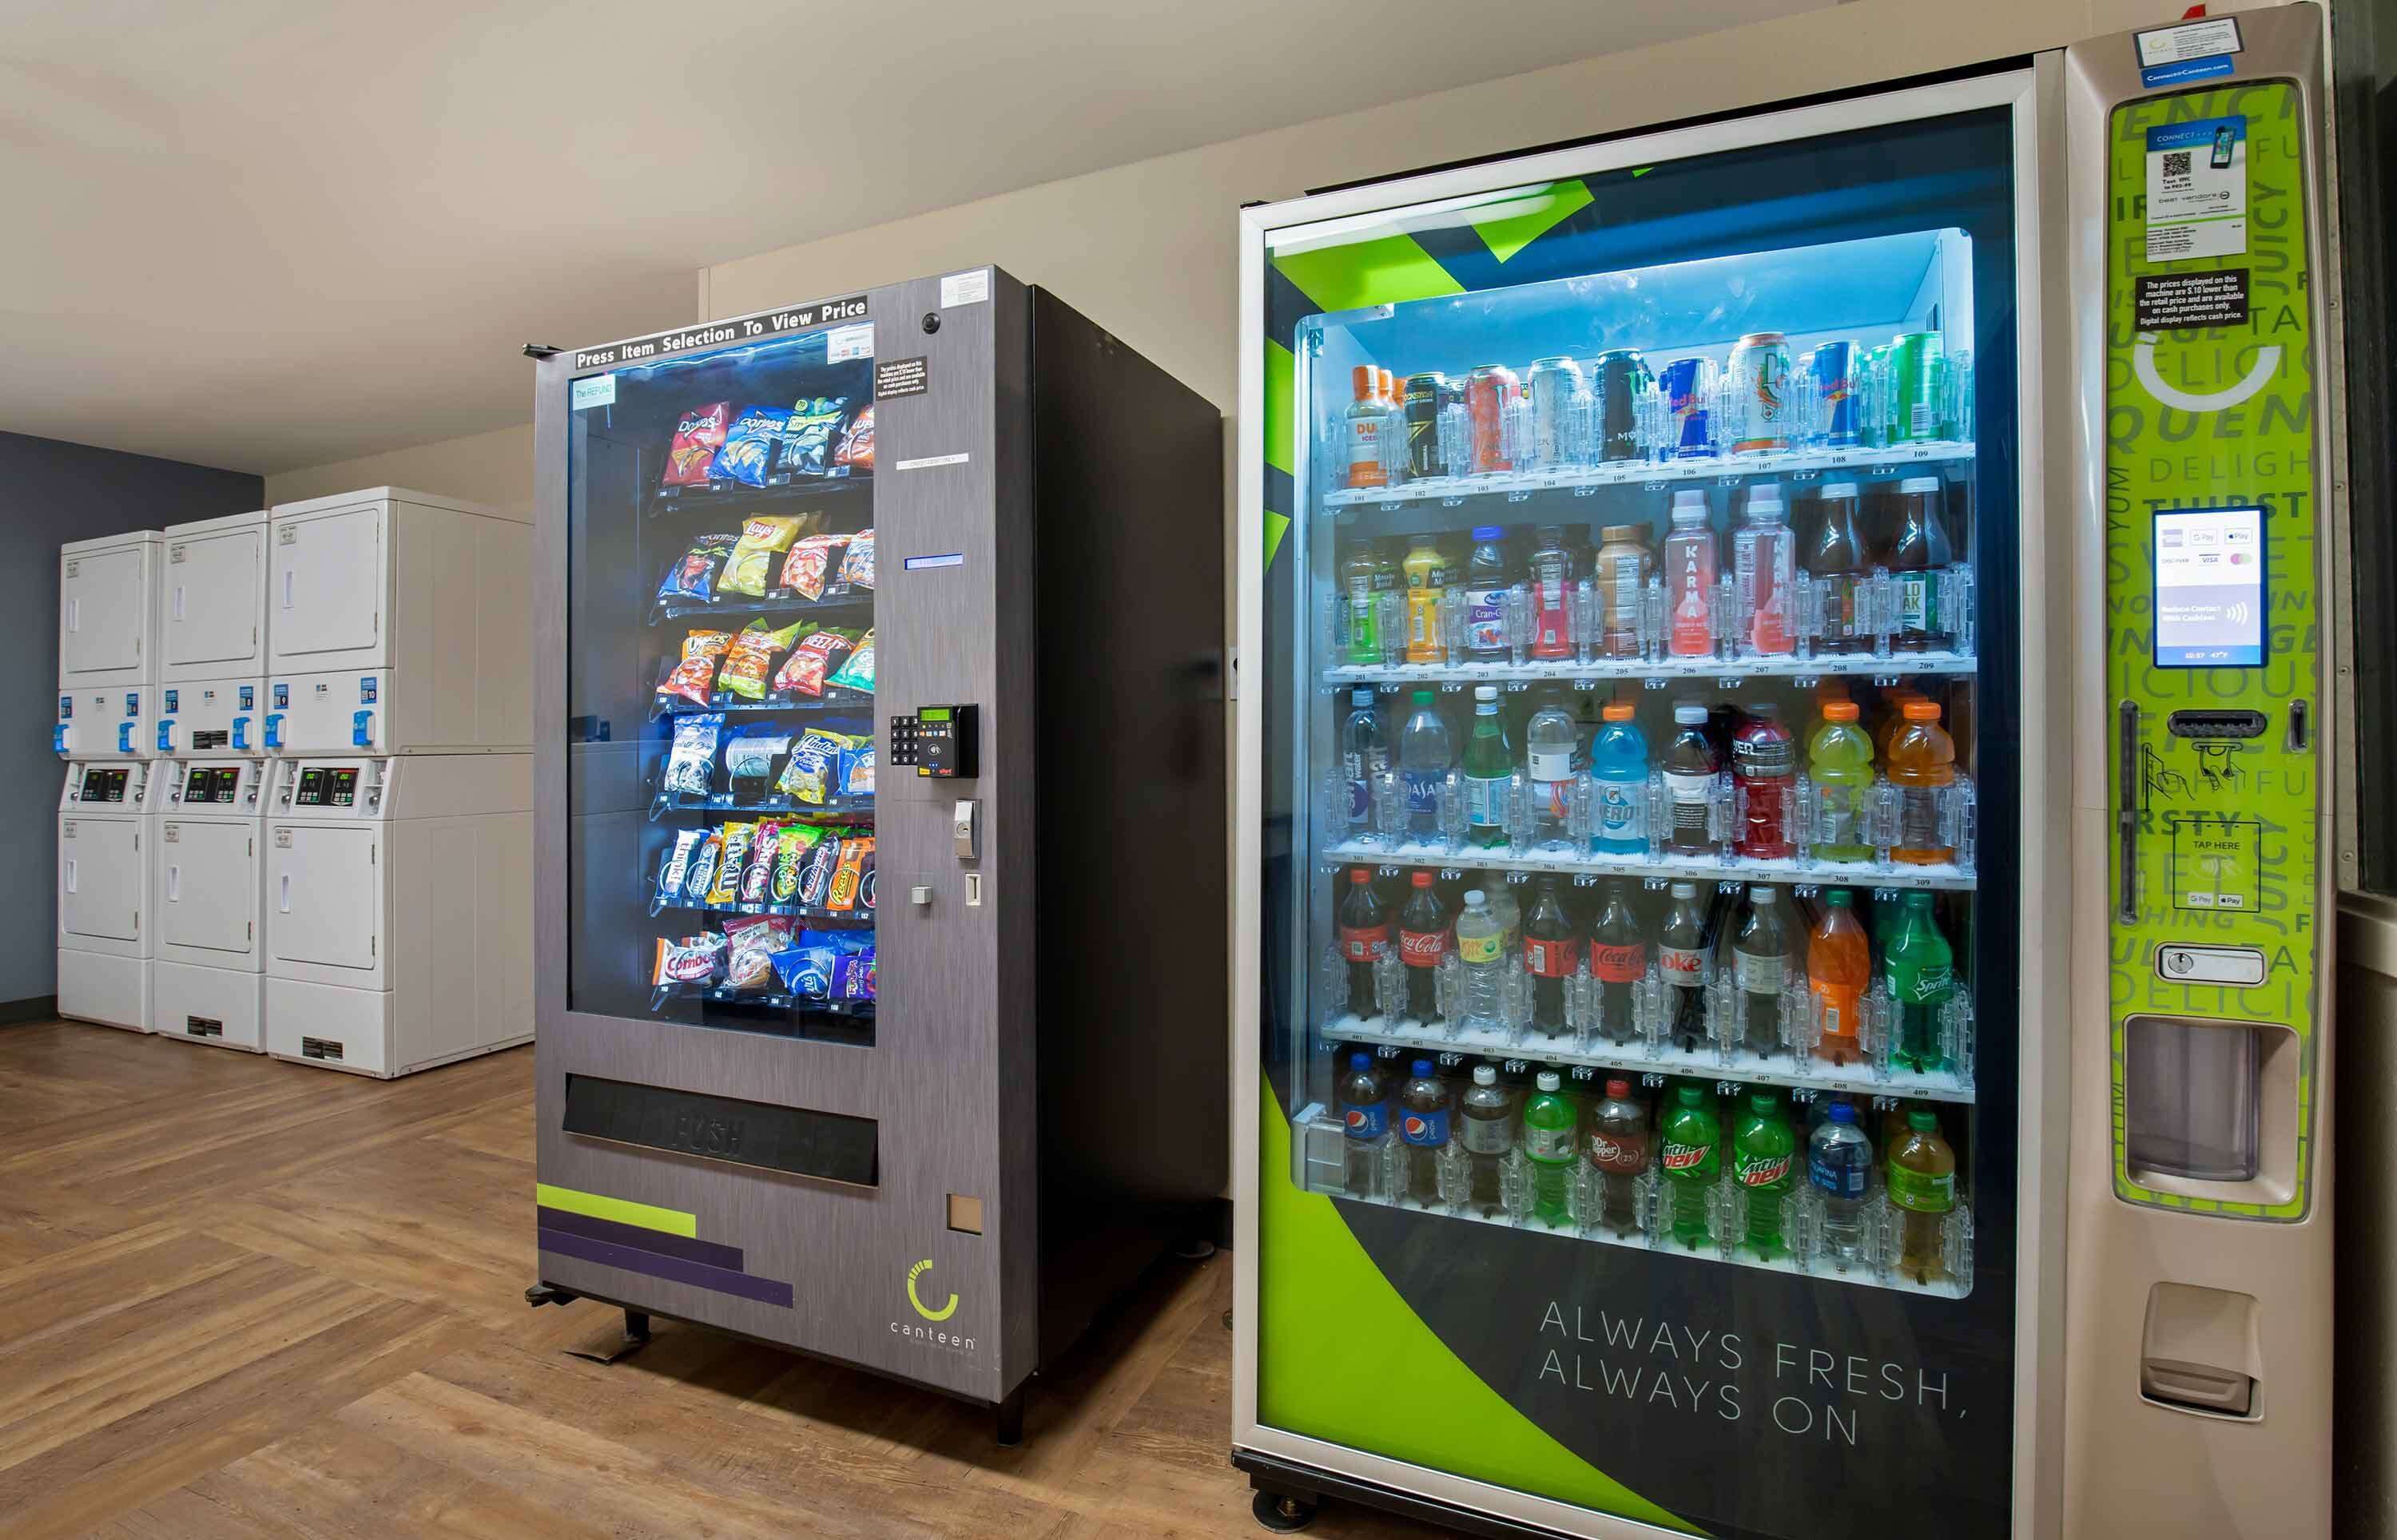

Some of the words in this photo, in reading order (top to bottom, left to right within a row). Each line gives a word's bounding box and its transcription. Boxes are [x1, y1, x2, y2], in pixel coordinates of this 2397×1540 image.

[2253, 181, 2288, 296] JUICY
[2160, 280, 2180, 291] prices
[2181, 277, 2213, 287] displayed
[2146, 288, 2174, 298] machine
[2169, 296, 2186, 305] price
[2214, 292, 2244, 301] available
[2179, 304, 2213, 314] purchases
[2215, 302, 2230, 311] only.
[2141, 317, 2159, 326] Digital
[577, 351, 614, 368] Press
[622, 344, 654, 359] Item
[662, 327, 735, 352] Selection
[744, 320, 763, 336] To
[772, 311, 812, 331] View
[822, 300, 865, 320] Price
[575, 390, 586, 399] The
[1685, 545, 1698, 617] KARMA
[2192, 840, 2212, 849] TAP
[2214, 841, 2240, 851] HERE
[2252, 812, 2289, 937] JUICY
[2198, 895, 2212, 905] Pay
[2227, 896, 2240, 905] Pay
[1832, 1082, 1847, 1090] 408
[672, 1109, 744, 1158] PUSH
[889, 1320, 972, 1351] canteen
[1540, 1300, 1743, 1370] ALWAYS
[1776, 1342, 1967, 1419] FRESH,
[1539, 1348, 1742, 1421] ALWAYS
[1772, 1396, 1857, 1446] ON
